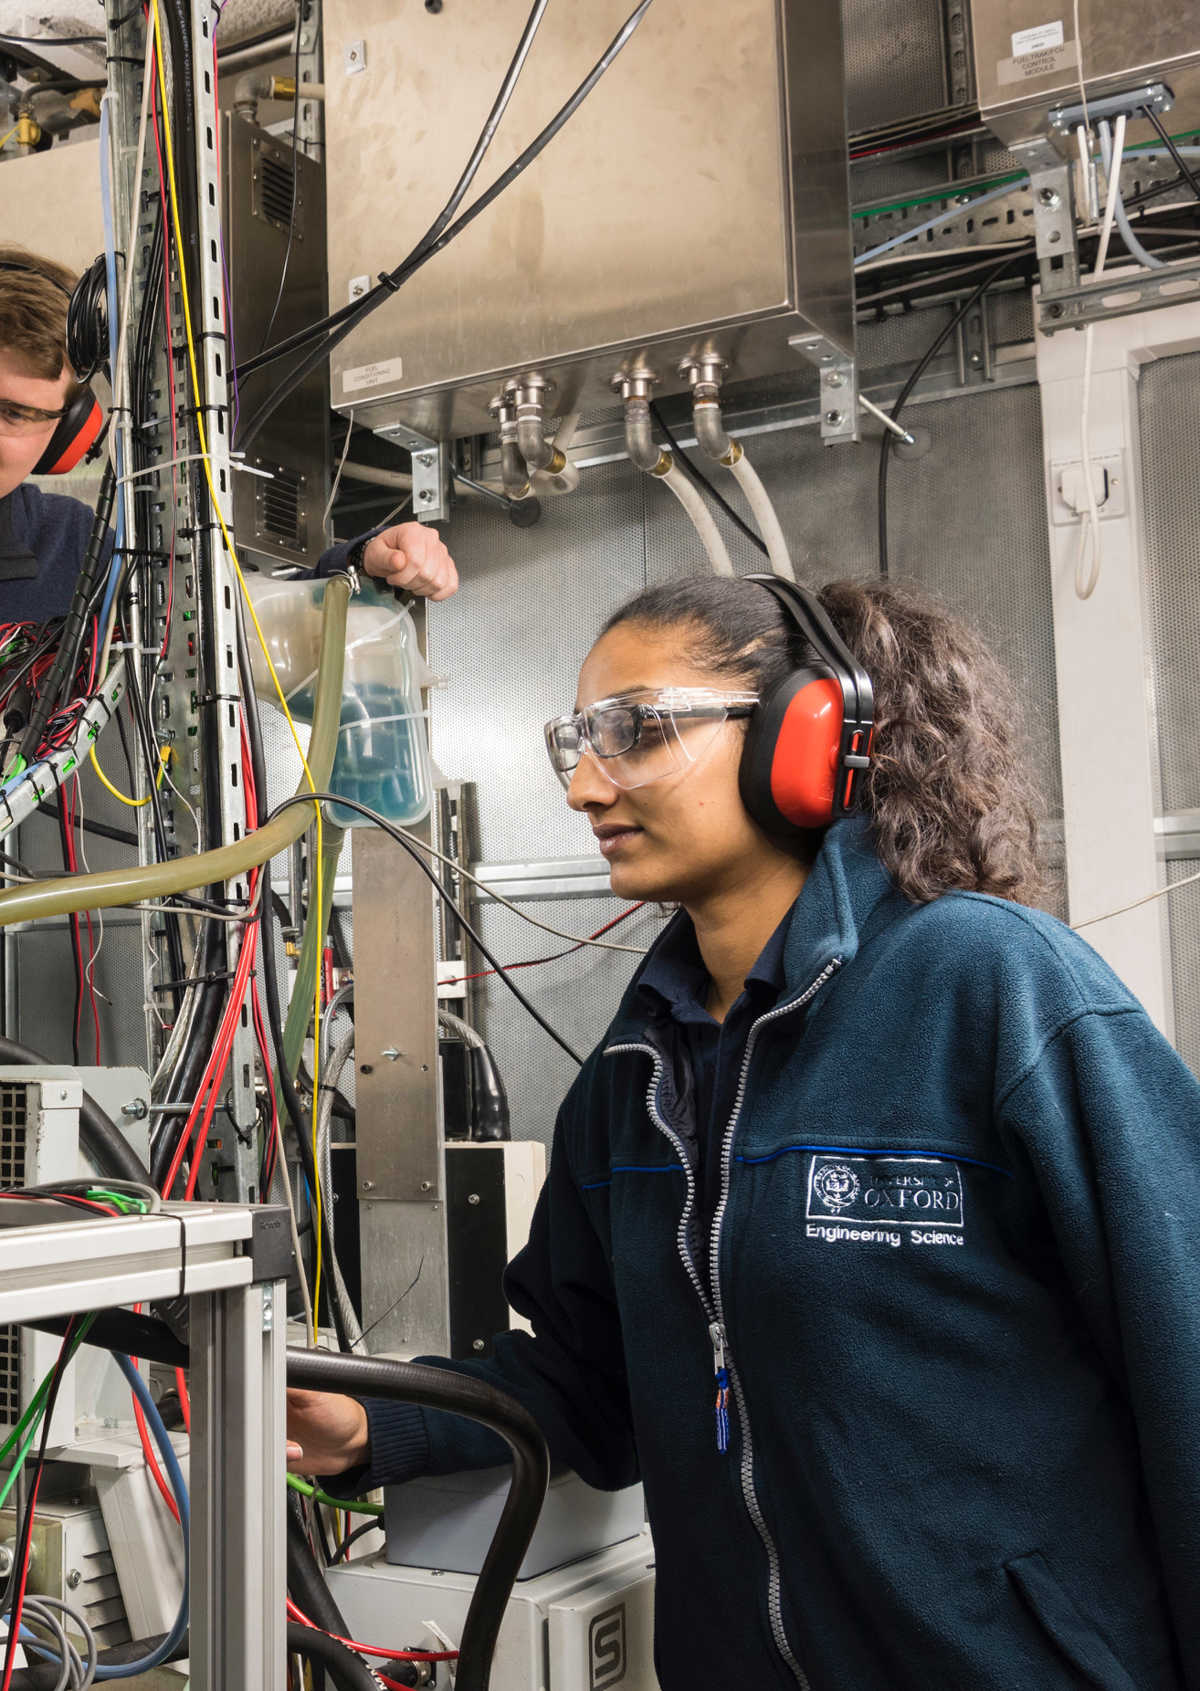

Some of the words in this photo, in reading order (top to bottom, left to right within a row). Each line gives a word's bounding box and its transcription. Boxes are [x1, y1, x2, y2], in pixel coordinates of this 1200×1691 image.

[1022, 55, 1057, 70] CONTROL
[1024, 63, 1056, 77] MODULE
[864, 1188, 959, 1210] OXFORD
[805, 1223, 901, 1247] Engineering
[911, 1229, 964, 1246] Science
